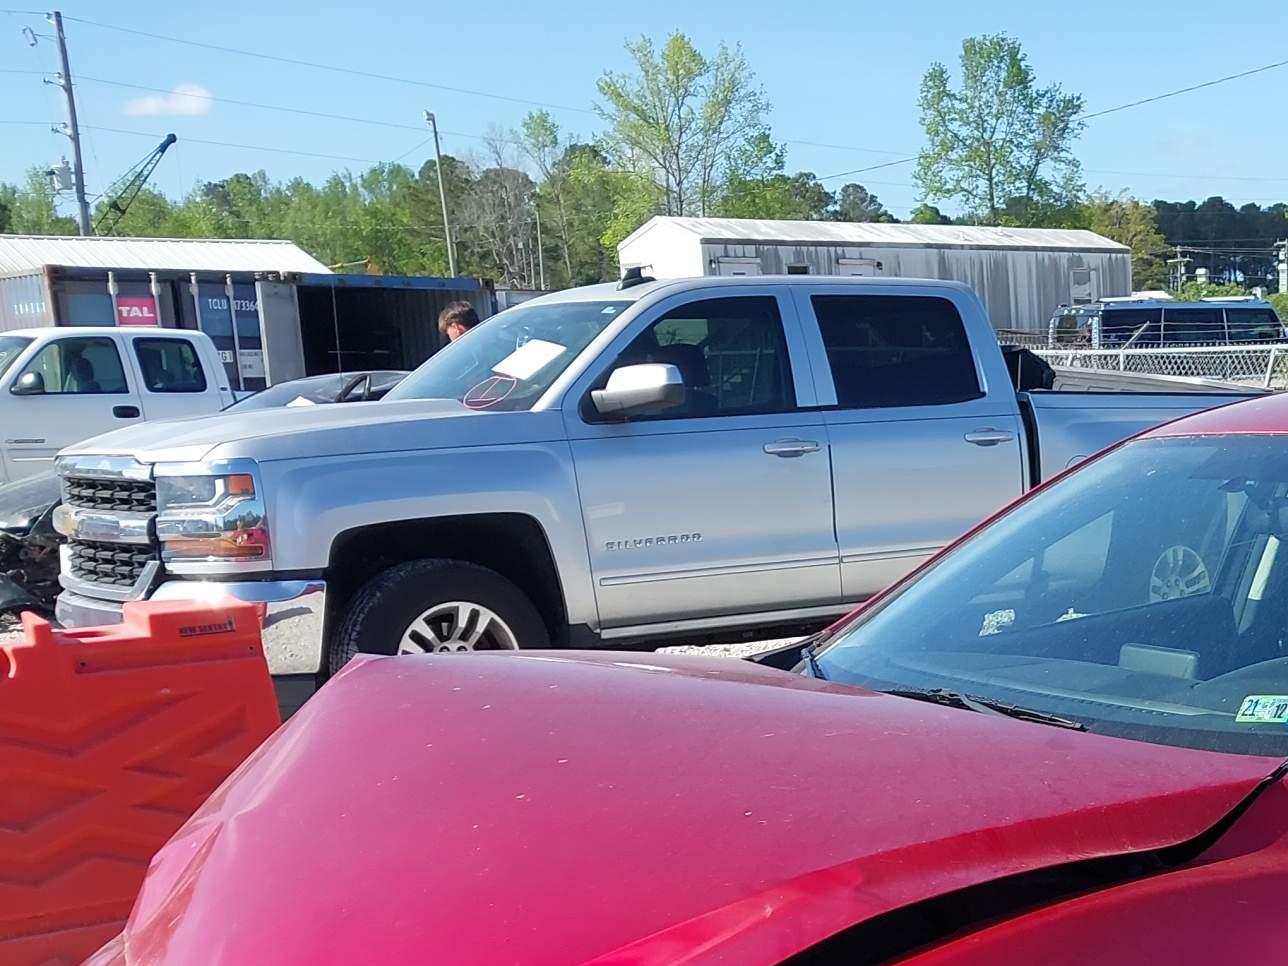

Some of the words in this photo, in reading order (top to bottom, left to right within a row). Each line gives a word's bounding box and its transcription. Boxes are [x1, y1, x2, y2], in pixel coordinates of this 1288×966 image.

[118, 306, 155, 317] TAL
[605, 532, 702, 551] SILVERADO
[1241, 699, 1259, 717] 21
[1272, 703, 1288, 719] 12
